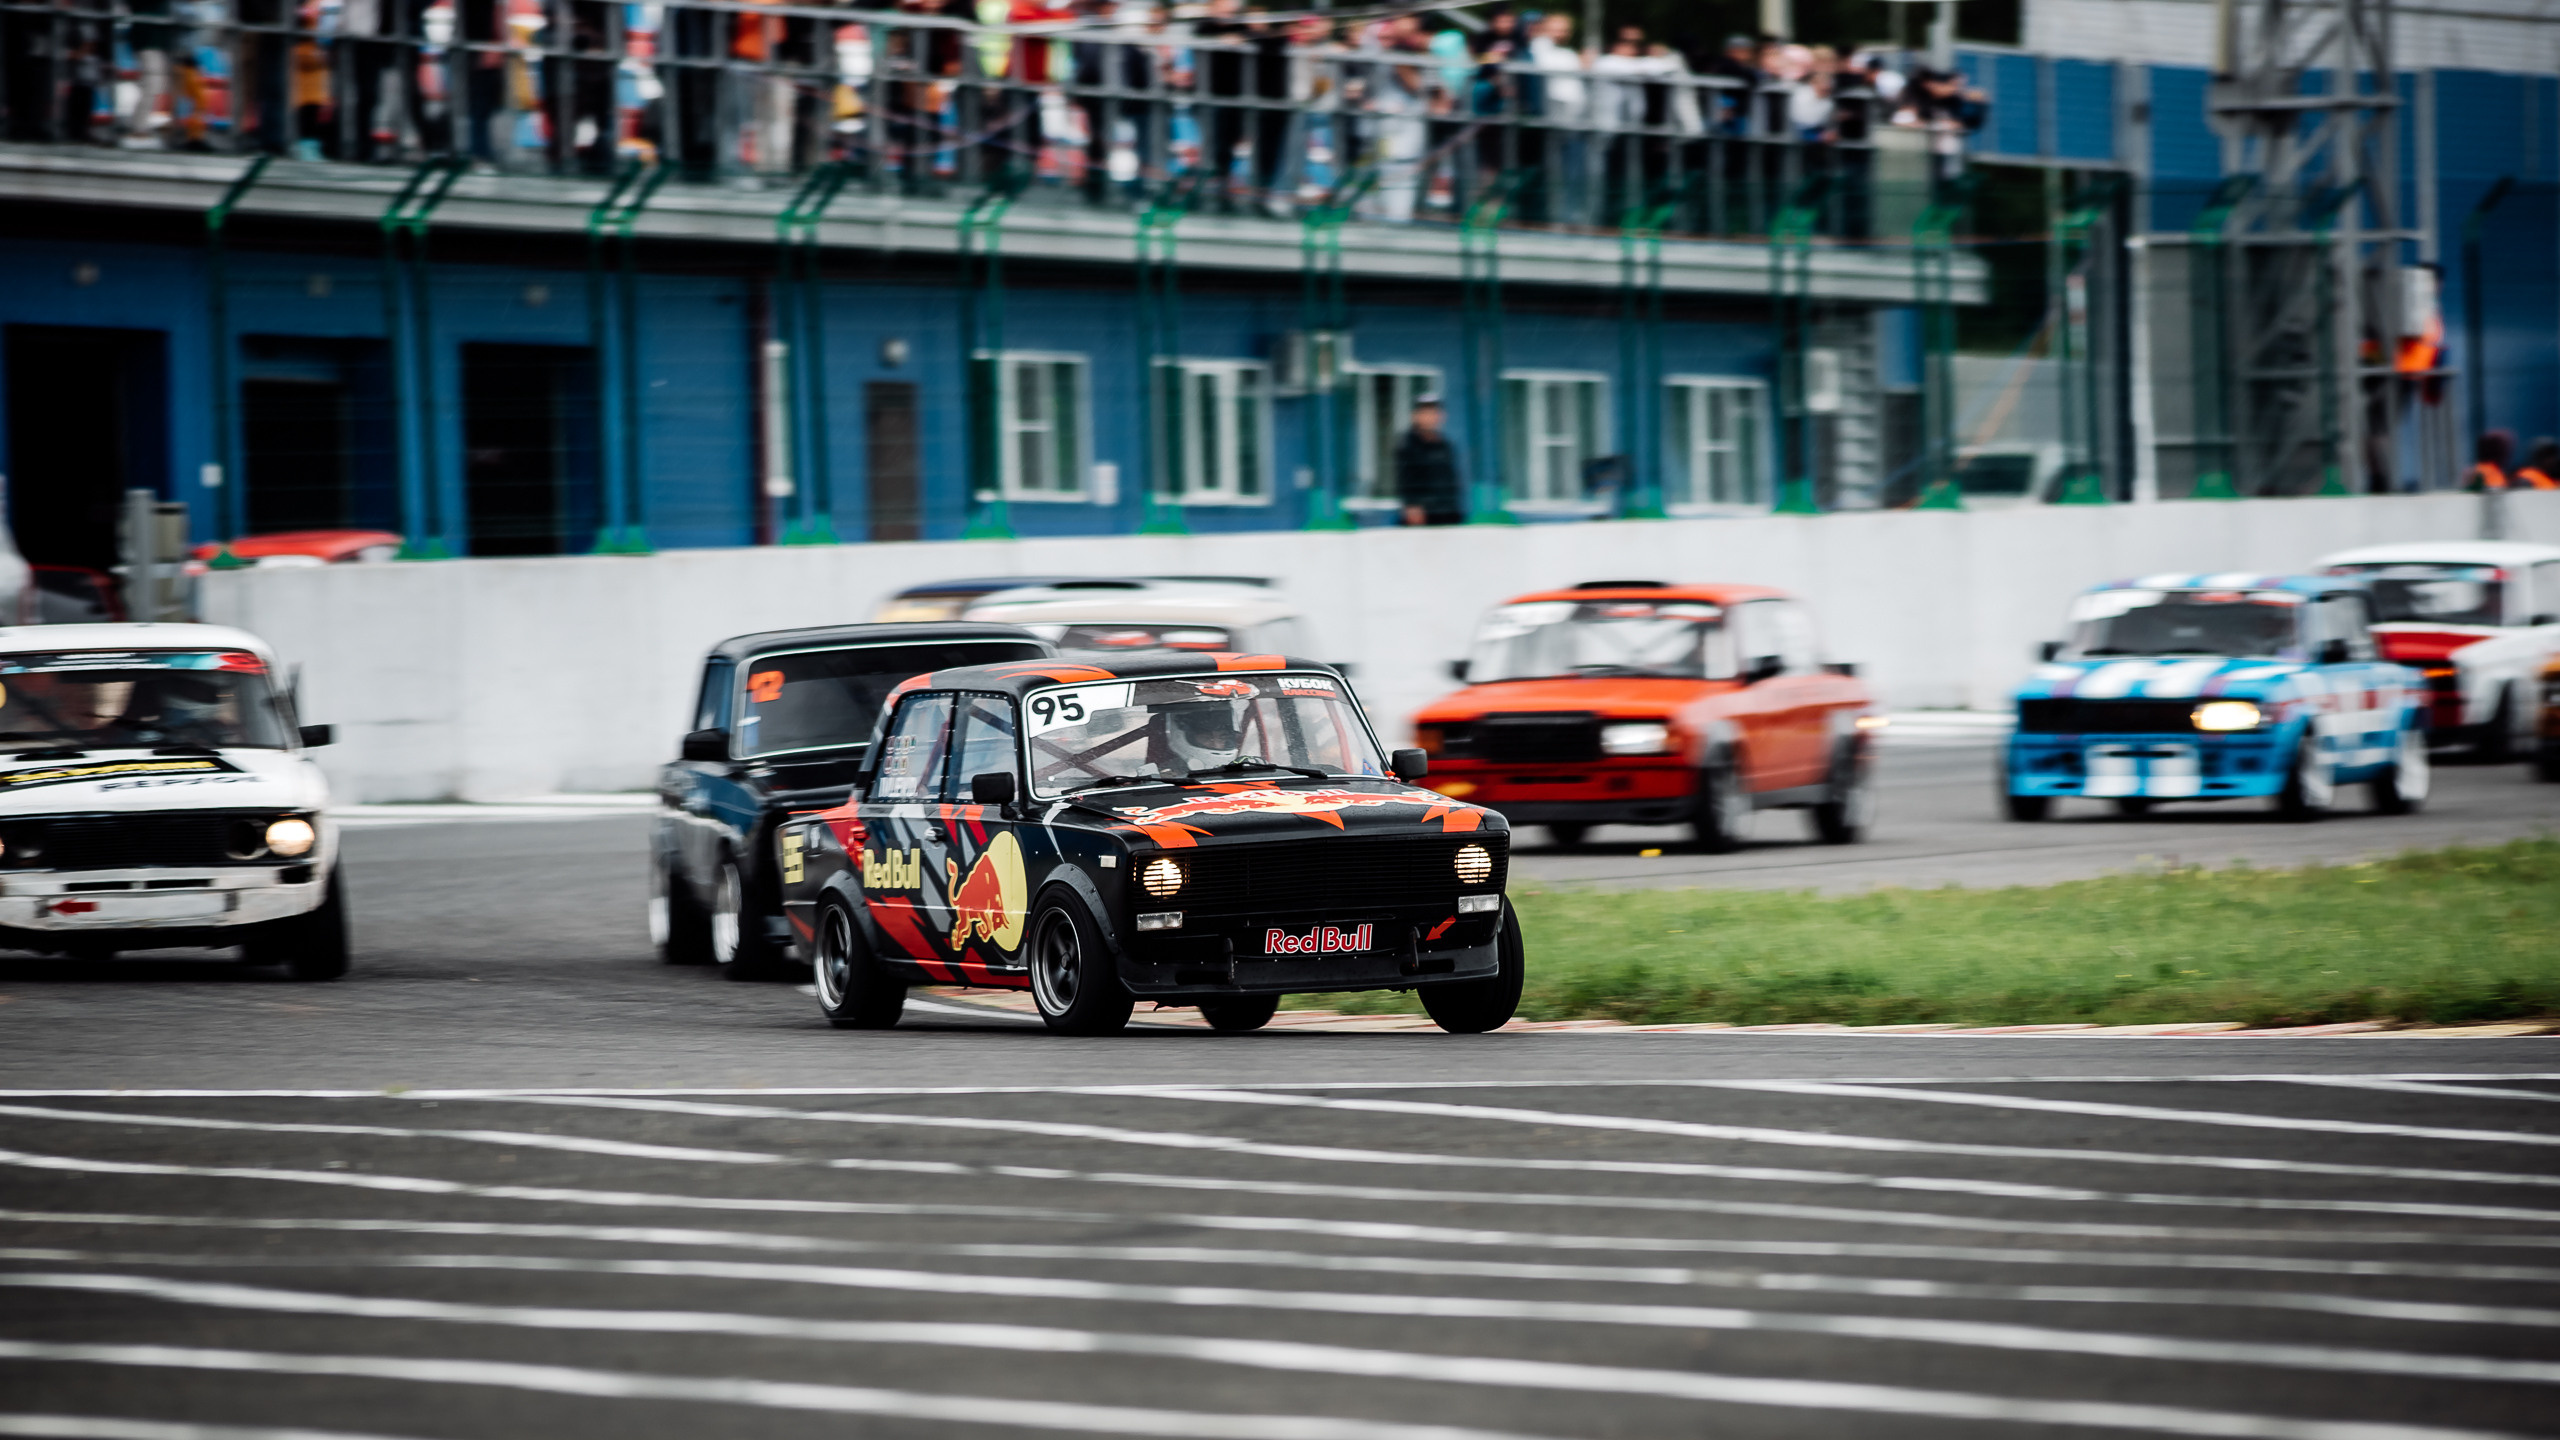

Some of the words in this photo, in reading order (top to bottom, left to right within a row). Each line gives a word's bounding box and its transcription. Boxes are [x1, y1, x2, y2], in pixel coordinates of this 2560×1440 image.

[1032, 693, 1084, 726] 95
[863, 848, 892, 888] Red
[892, 848, 921, 889] Bull
[1265, 926, 1320, 954] Red
[1321, 924, 1373, 952] Bull
